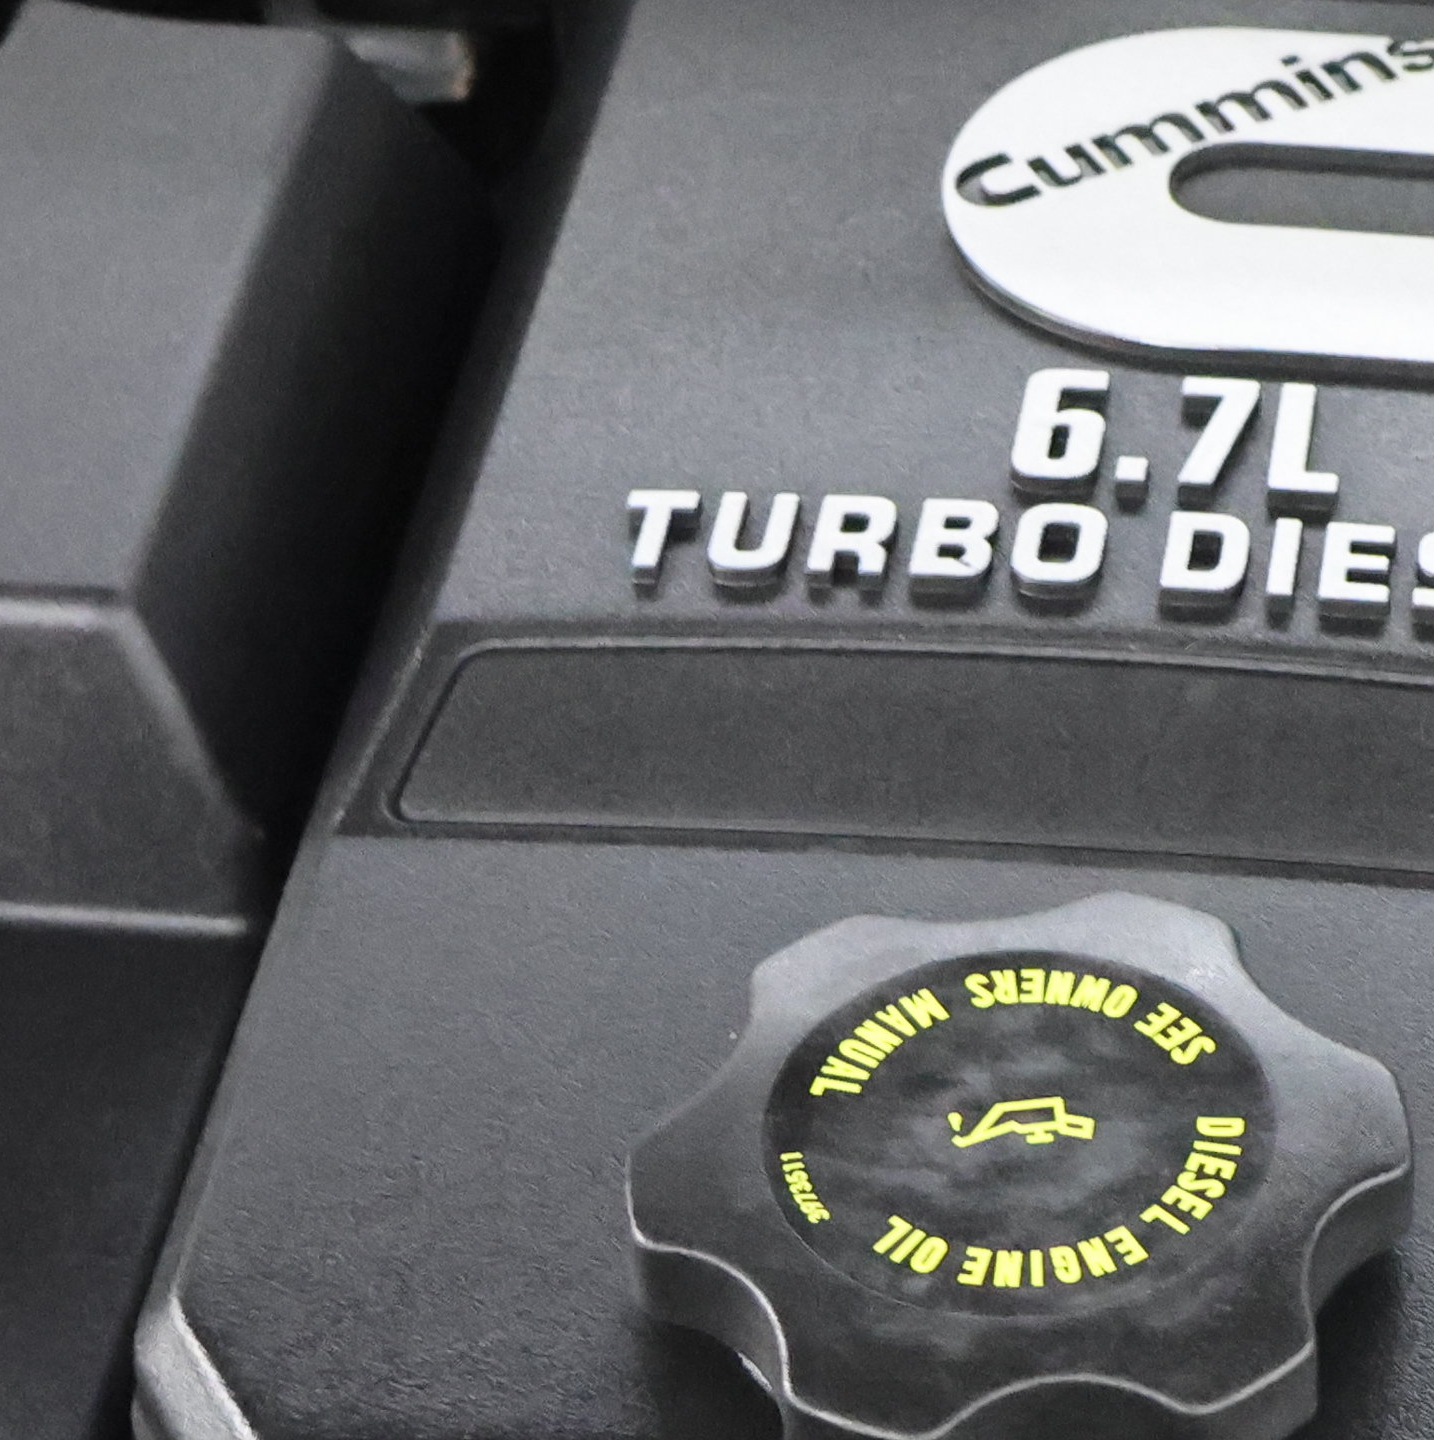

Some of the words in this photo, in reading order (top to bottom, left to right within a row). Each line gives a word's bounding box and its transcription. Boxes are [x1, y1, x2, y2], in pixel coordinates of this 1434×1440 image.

[1010, 367, 1340, 500] 6.7L
[625, 488, 1110, 592] TURBO
[963, 967, 1139, 1019] OWNERS
[809, 987, 951, 1097] MANUAL
[1132, 1001, 1217, 1067] SEE
[779, 1151, 831, 1225] 3973511
[1138, 1115, 1246, 1236] DIESEL
[871, 1214, 950, 1275] OIL
[956, 1225, 1150, 1289] ENGINE
